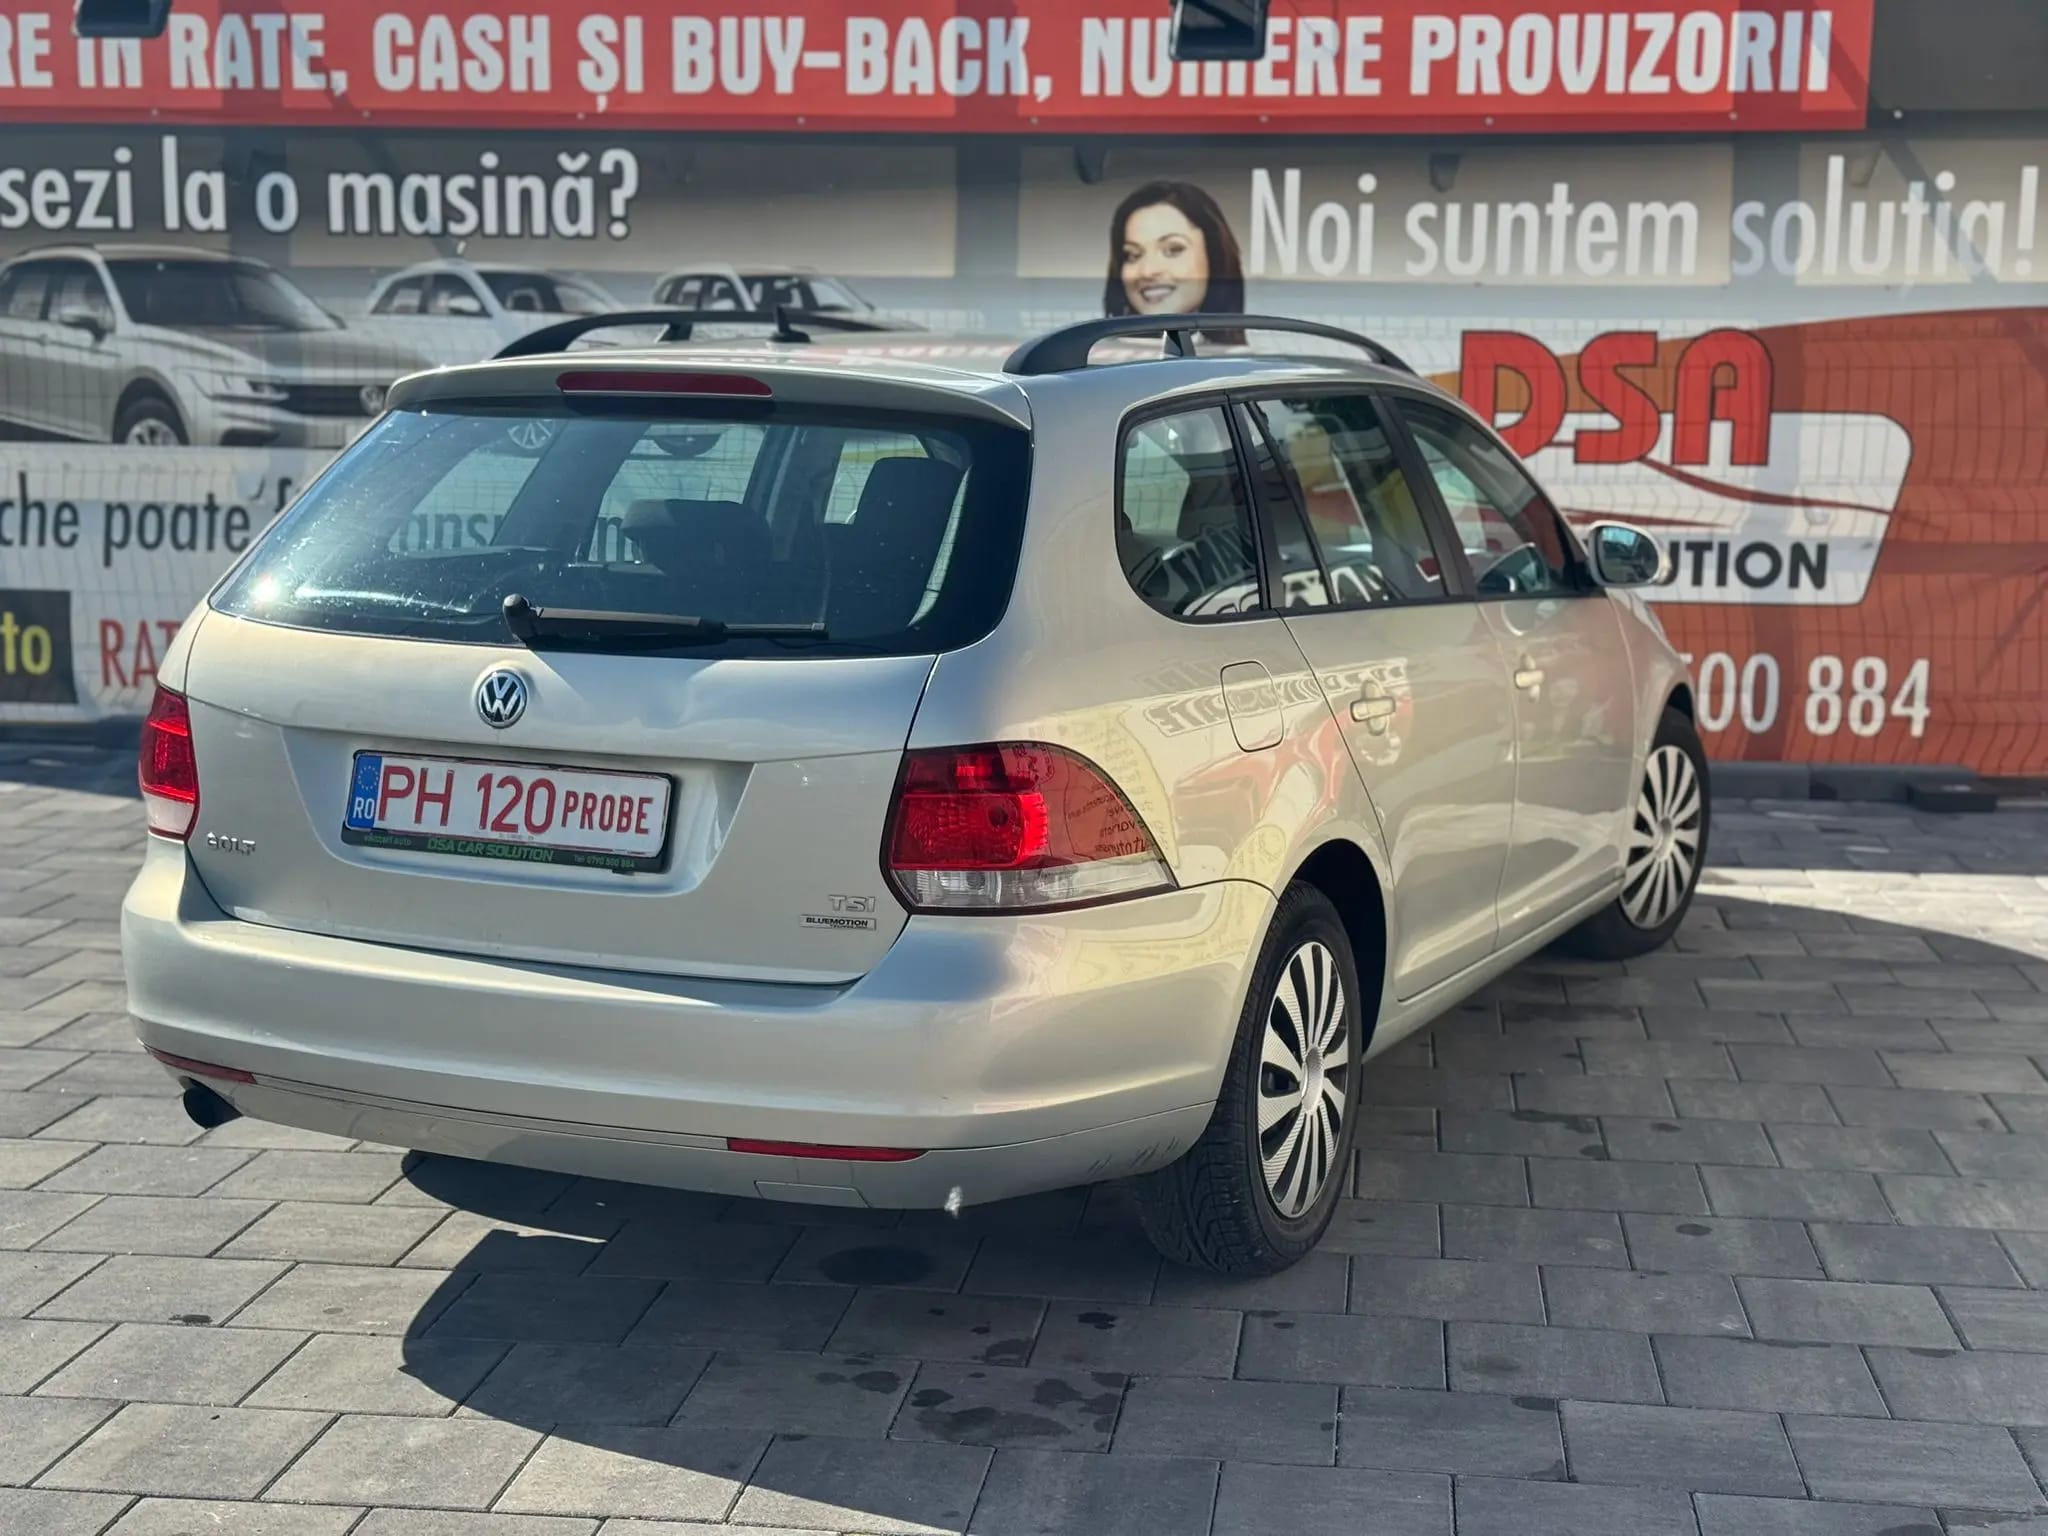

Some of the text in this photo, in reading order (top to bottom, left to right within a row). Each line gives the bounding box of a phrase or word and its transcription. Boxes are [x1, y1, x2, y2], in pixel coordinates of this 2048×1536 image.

[169, 14, 348, 96] RATE,
[373, 15, 550, 91] CASH
[1410, 11, 1831, 95] PROVIZORII
[0, 147, 133, 229] sezi
[162, 136, 226, 230] la
[256, 174, 298, 232] o
[1250, 168, 1377, 276] Noi
[1405, 182, 1699, 277] suntem
[1459, 328, 1774, 466] DSA
[104, 493, 250, 567] poate
[1654, 541, 1828, 589] UTION
[1679, 652, 1931, 738] 00 884
[352, 796, 375, 820] RO
[378, 765, 654, 835] PH 120 PROBE
[427, 836, 456, 852] DSA
[485, 844, 555, 863] SOLUTION
[805, 917, 869, 926] BLUEMOTION
[828, 894, 876, 913] TSI
